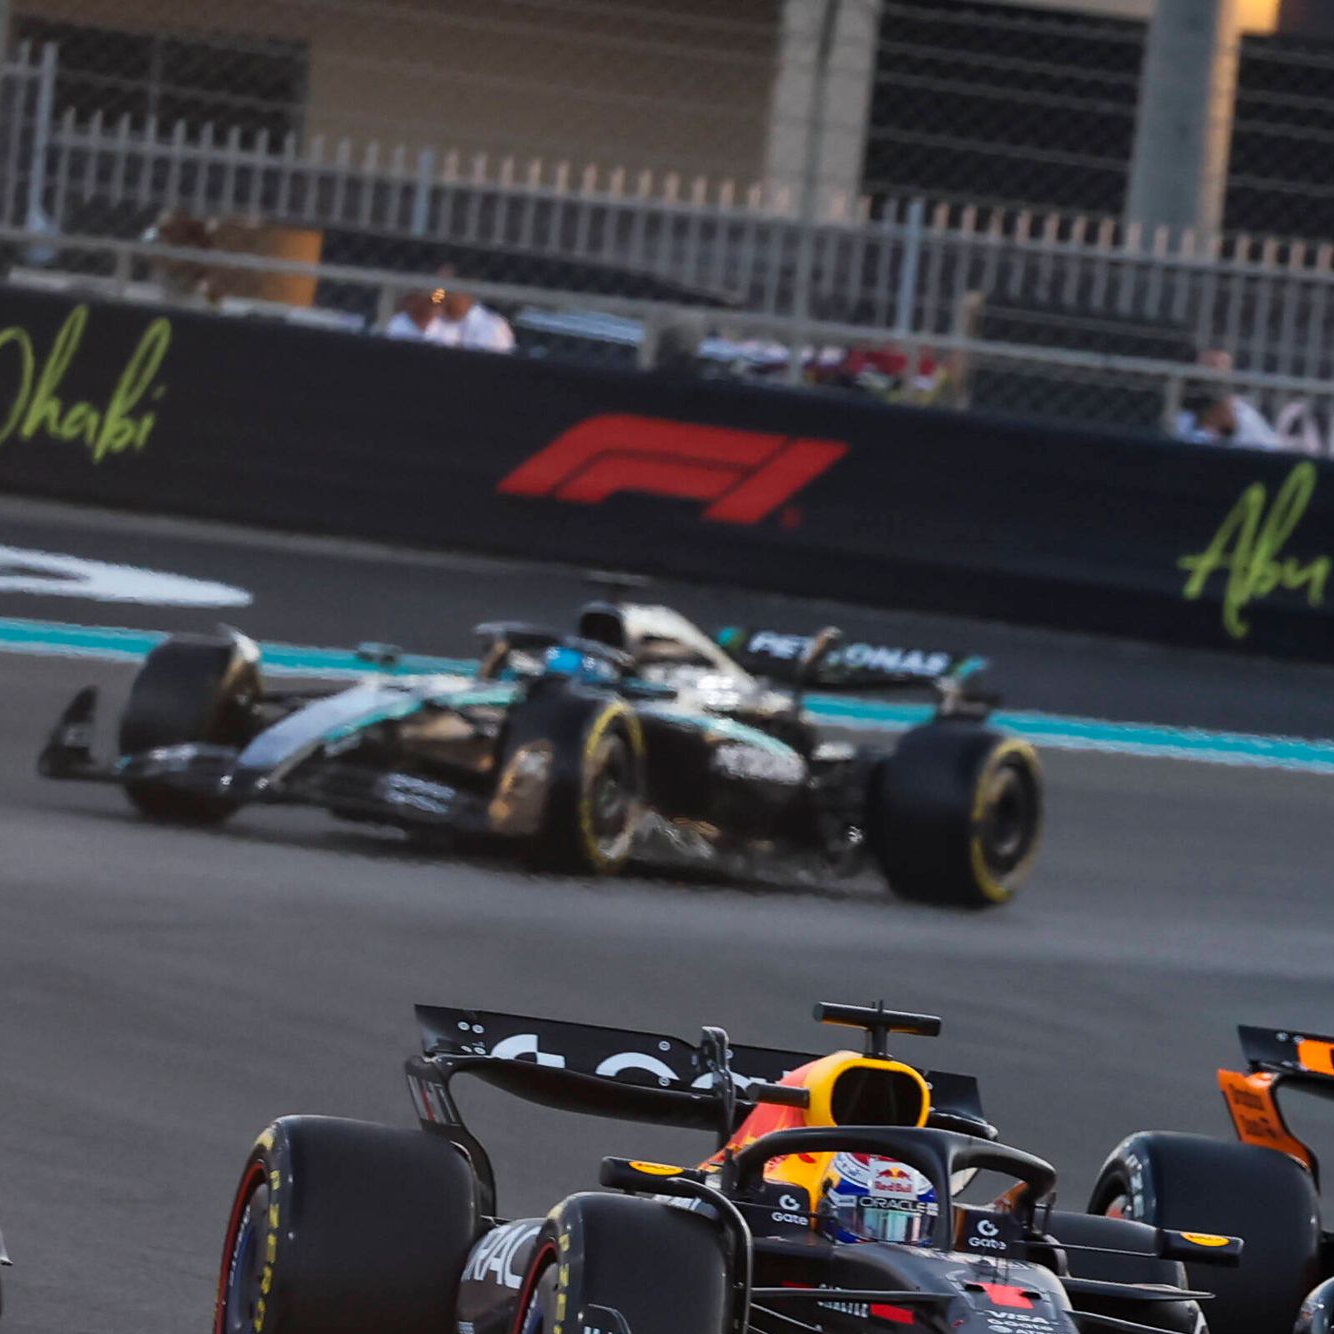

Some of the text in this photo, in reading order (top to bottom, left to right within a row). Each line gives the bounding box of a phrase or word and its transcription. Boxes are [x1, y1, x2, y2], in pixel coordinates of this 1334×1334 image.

[496, 414, 849, 525] F1
[1178, 461, 1333, 639] Abu
[860, 1197, 926, 1213] ORACLE
[772, 1212, 809, 1226] Gate
[969, 1236, 1007, 1250] Gate
[985, 1309, 1051, 1325] VISA
